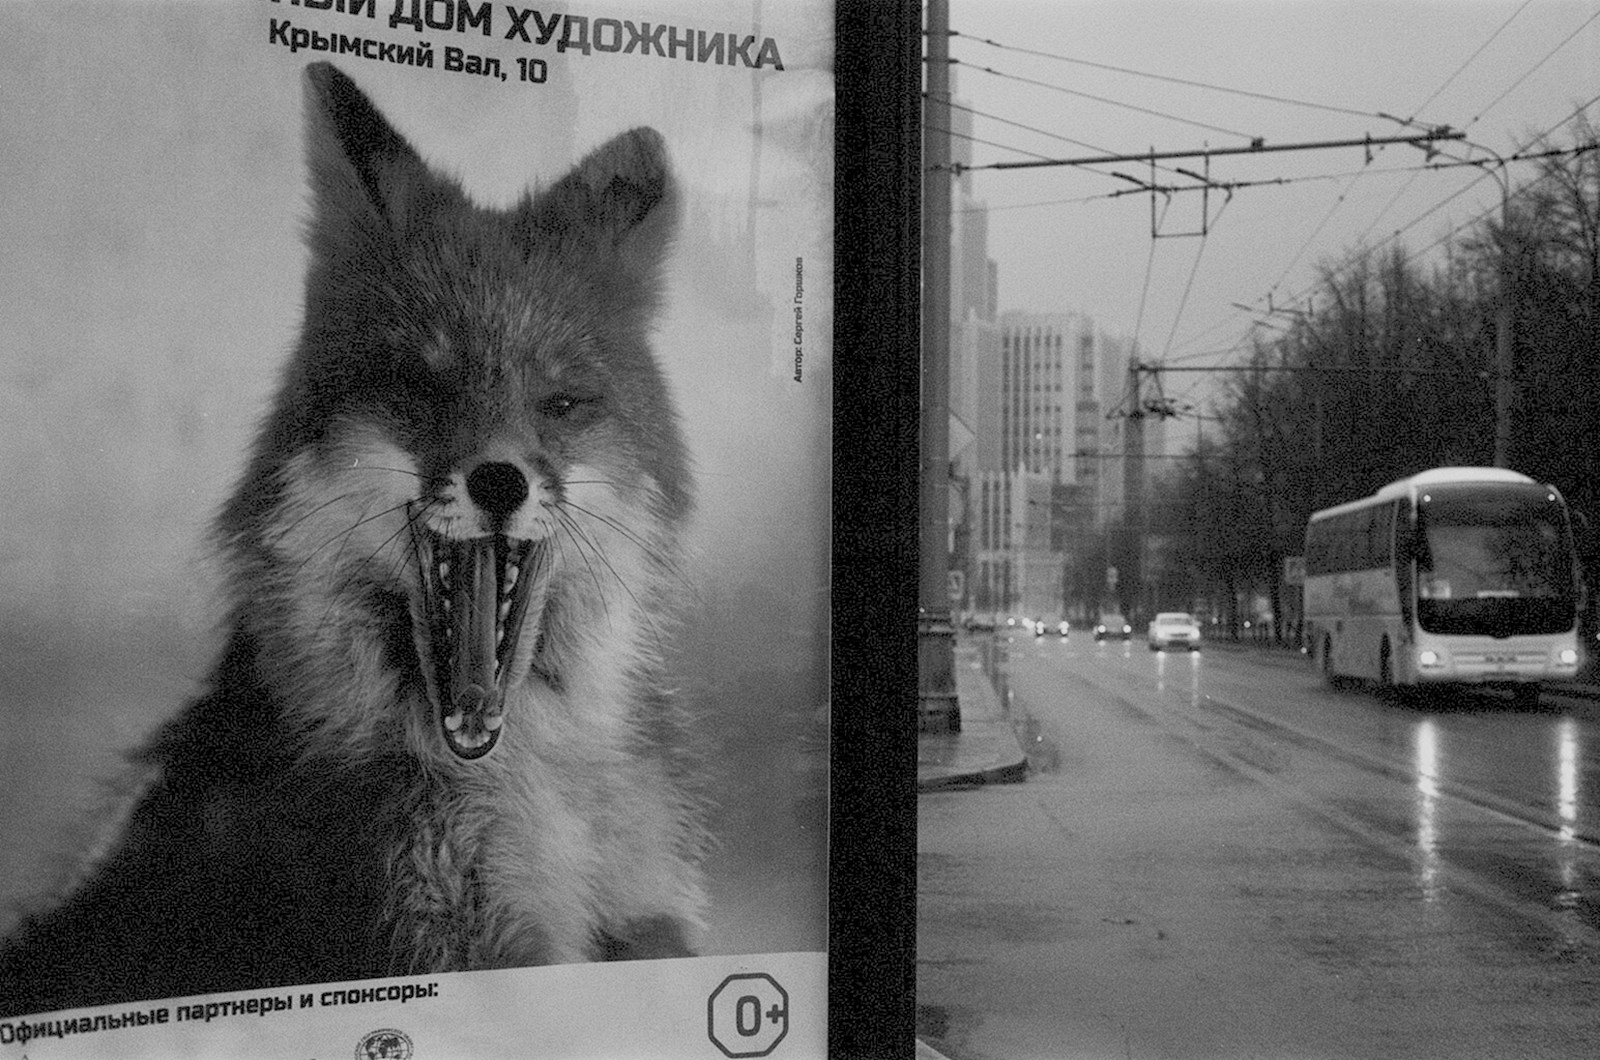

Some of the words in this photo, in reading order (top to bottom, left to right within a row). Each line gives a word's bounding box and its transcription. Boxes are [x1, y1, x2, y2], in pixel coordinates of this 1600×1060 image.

[269, 18, 434, 68] Крымский
[444, 46, 507, 82] Вал,
[516, 57, 548, 84] 10
[389, 0, 492, 36] ДОМ
[504, 5, 784, 71] ХУДОЖНИКА
[793, 257, 804, 304] Горшков
[793, 307, 804, 345] Сергей
[793, 346, 804, 383] Автор:
[0, 1007, 169, 1045] Официальные
[177, 995, 293, 1023] партнеры
[300, 993, 314, 1008] и
[320, 982, 439, 1007] спонсоры:
[735, 995, 785, 1037] 0+
